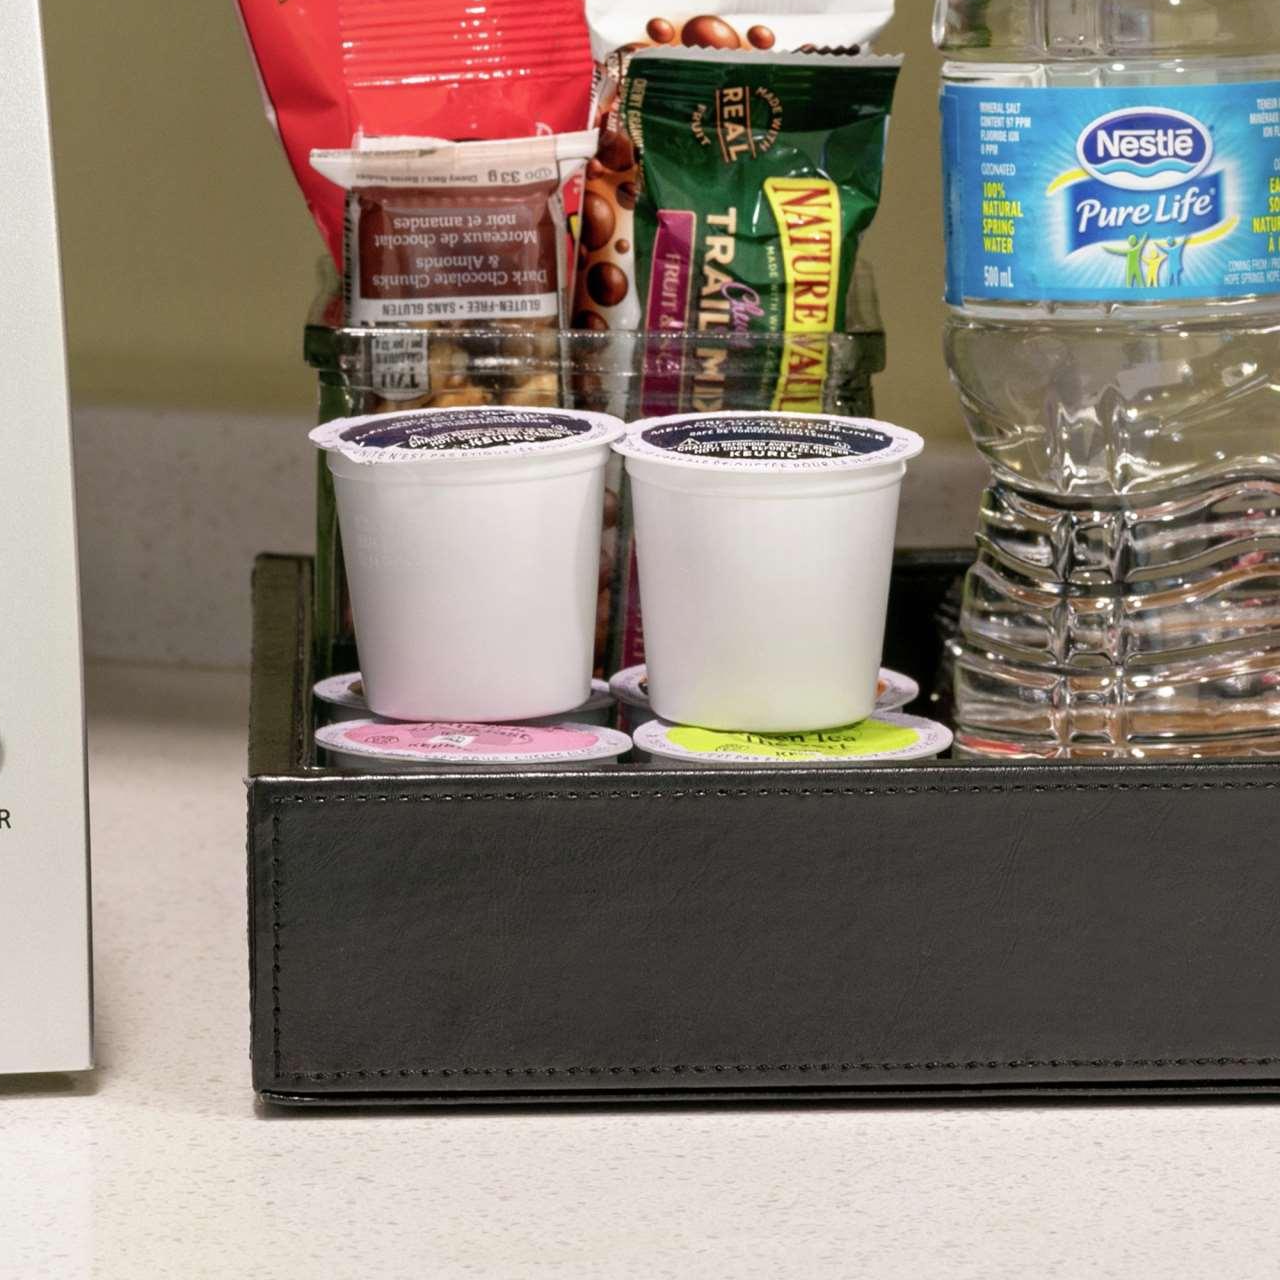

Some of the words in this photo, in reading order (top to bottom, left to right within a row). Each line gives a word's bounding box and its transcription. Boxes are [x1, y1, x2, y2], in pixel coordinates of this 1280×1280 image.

[722, 86, 745, 161] REAL
[1096, 128, 1194, 157] Nestlé
[487, 169, 498, 183] g
[501, 170, 521, 183] 33
[982, 182, 1006, 198] 100%
[982, 200, 1024, 218] NATURAL
[1076, 198, 1153, 233] Pure
[1154, 186, 1213, 223] Life
[393, 215, 460, 229] amandes
[468, 215, 482, 226] et
[487, 213, 517, 225] noir
[982, 219, 1016, 235] SPRING
[374, 233, 437, 248] chocolat
[440, 232, 459, 243] de
[463, 229, 538, 243] Morceaux
[982, 237, 1014, 254] WATER
[416, 255, 483, 269] Almonds
[487, 255, 500, 266] &
[772, 186, 831, 325] NATURE
[512, 269, 548, 283] Dark
[696, 206, 737, 332] TRAIL
[372, 274, 431, 288] Chunks
[434, 270, 509, 285] Chocolate
[984, 266, 999, 287] 500
[1000, 267, 1014, 288] mL
[381, 302, 425, 317] GLUTEN
[430, 301, 457, 315] SANS
[469, 298, 542, 312] GLUTEN-FREE
[778, 332, 827, 411] VALL
[729, 451, 798, 459] KEURIG
